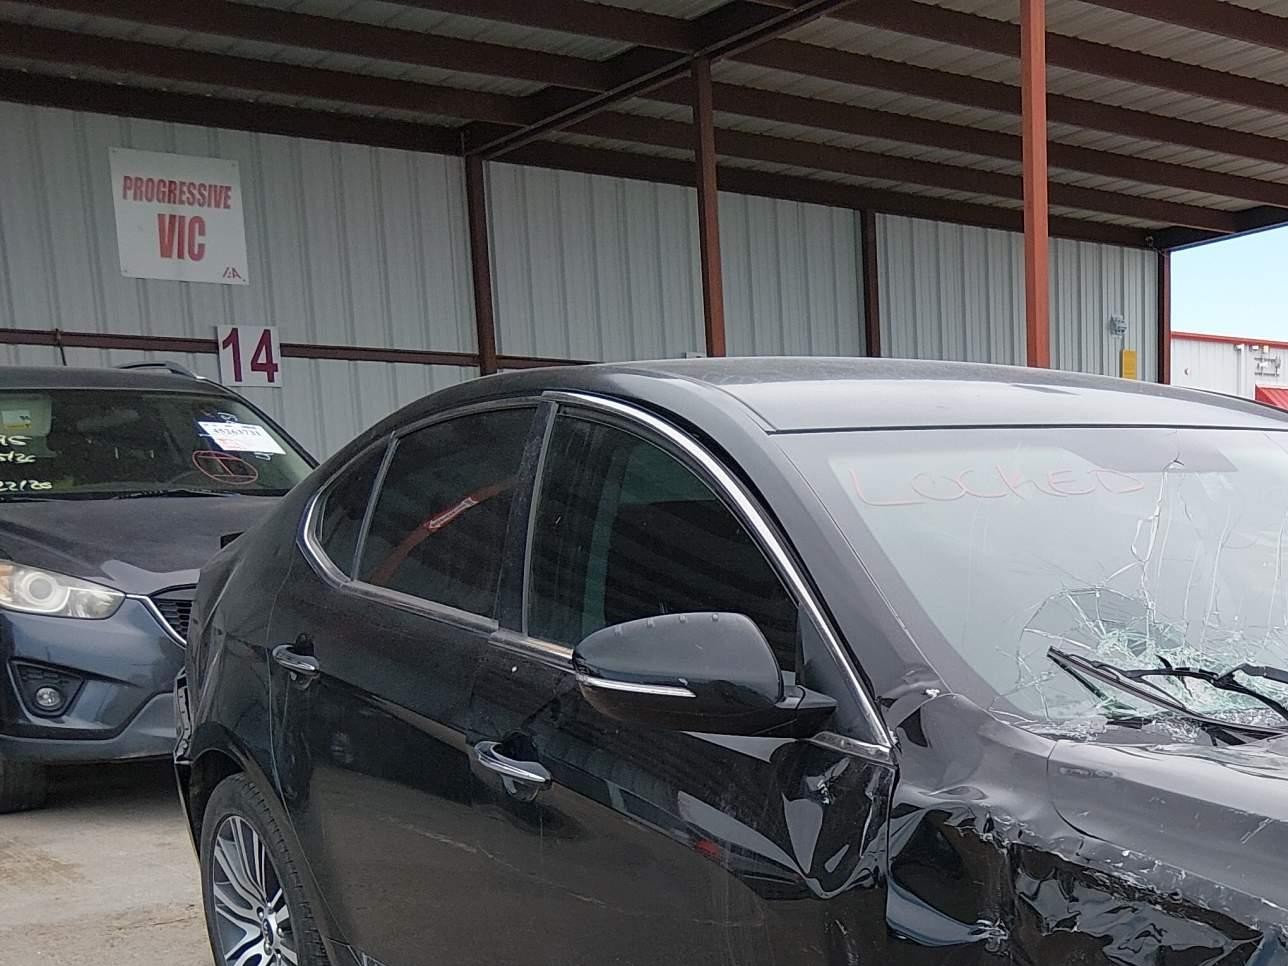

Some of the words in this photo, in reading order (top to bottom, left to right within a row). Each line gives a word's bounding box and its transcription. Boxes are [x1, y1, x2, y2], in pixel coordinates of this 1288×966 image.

[122, 175, 232, 210] PROGRESSIVE
[157, 213, 207, 262] VIC
[222, 327, 279, 384] 14
